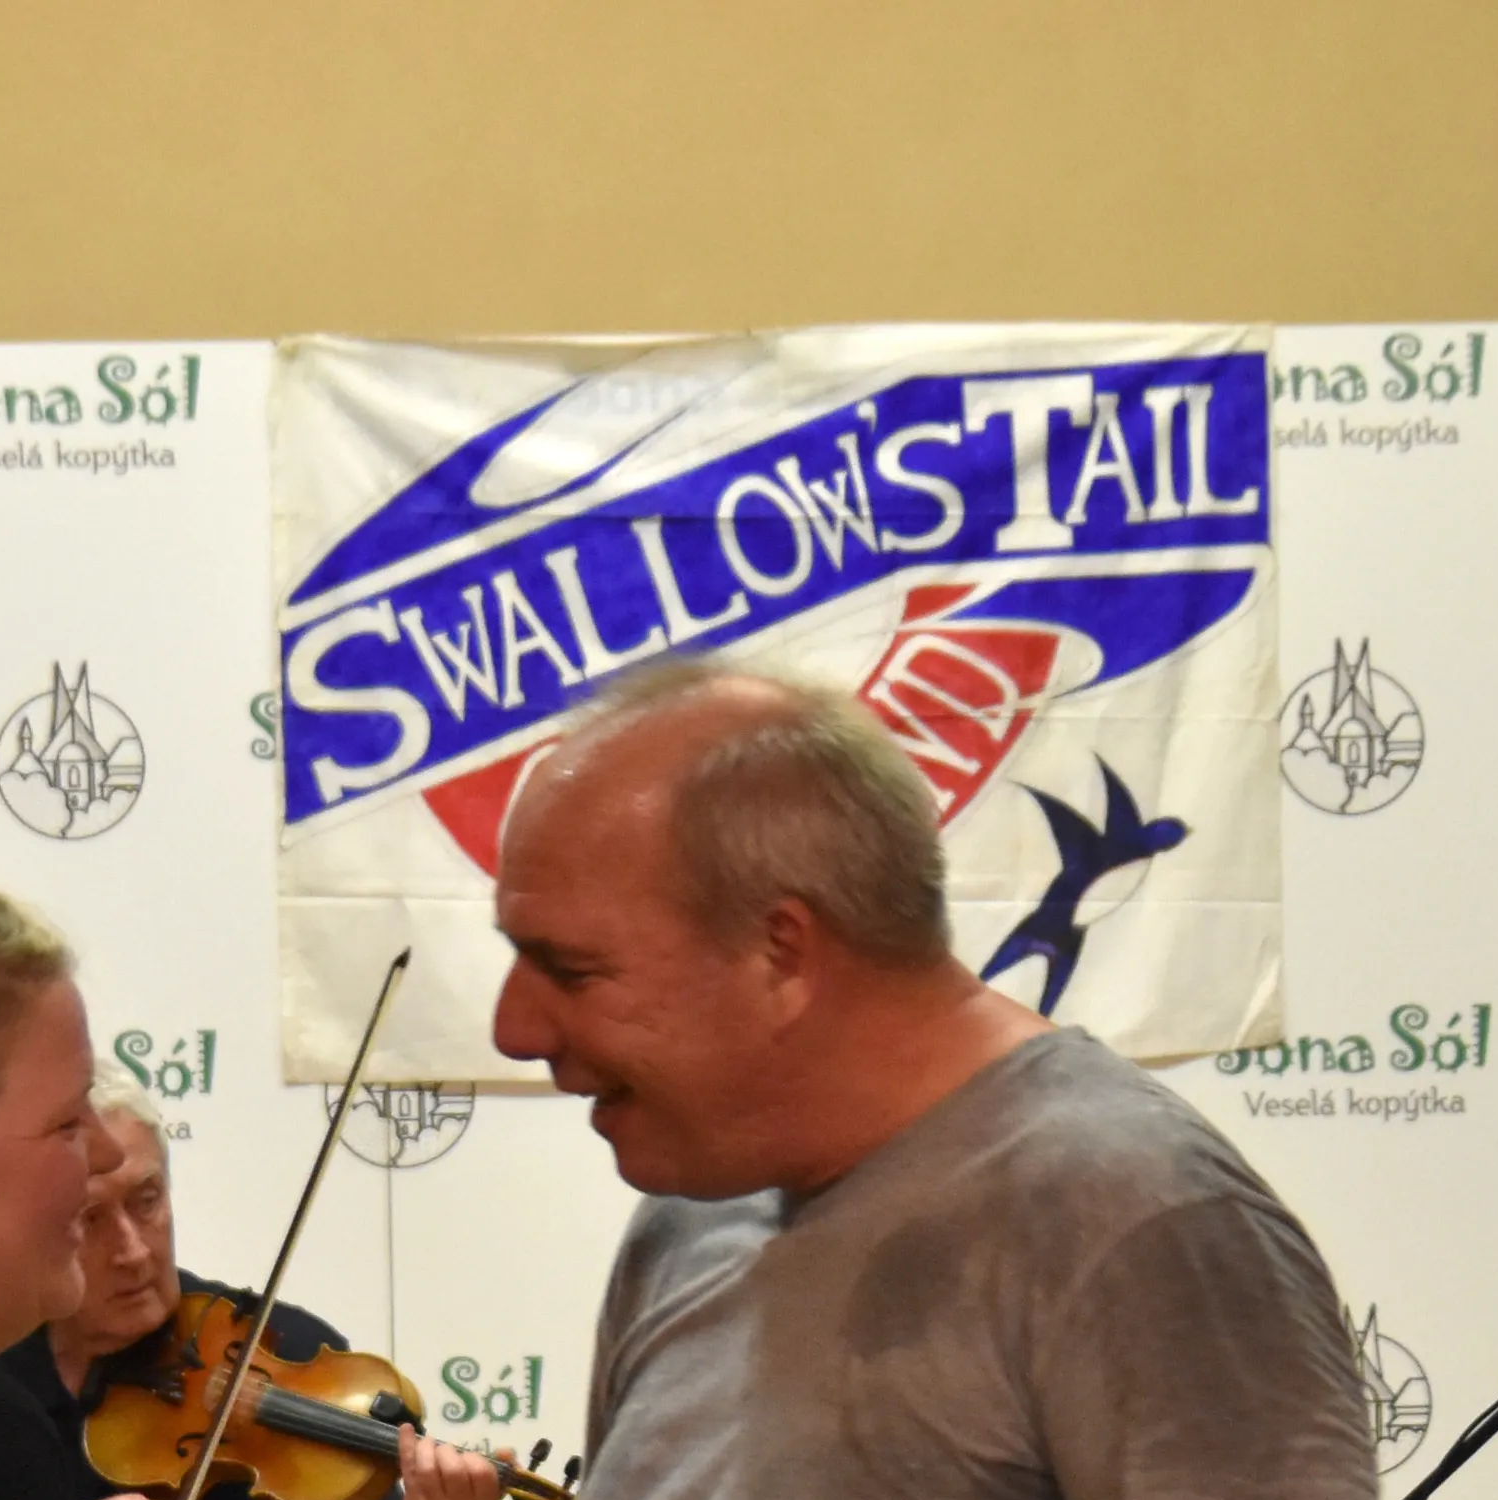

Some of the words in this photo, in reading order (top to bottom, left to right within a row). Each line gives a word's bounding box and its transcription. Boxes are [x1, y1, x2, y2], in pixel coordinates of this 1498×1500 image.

[97, 354, 201, 425] Sól
[1273, 365, 1369, 404] na
[1382, 332, 1486, 403] Sól
[56, 440, 176, 476] kopýtka
[962, 373, 1260, 552] TAIL
[1275, 417, 1328, 448] selá
[1339, 416, 1460, 454] kopýtka
[867, 634, 1019, 812] ND
[1389, 1003, 1492, 1073] Sól
[1242, 1088, 1337, 1118] Veselá
[1346, 1086, 1467, 1122] kopýtka
[441, 1355, 543, 1424] Sól
